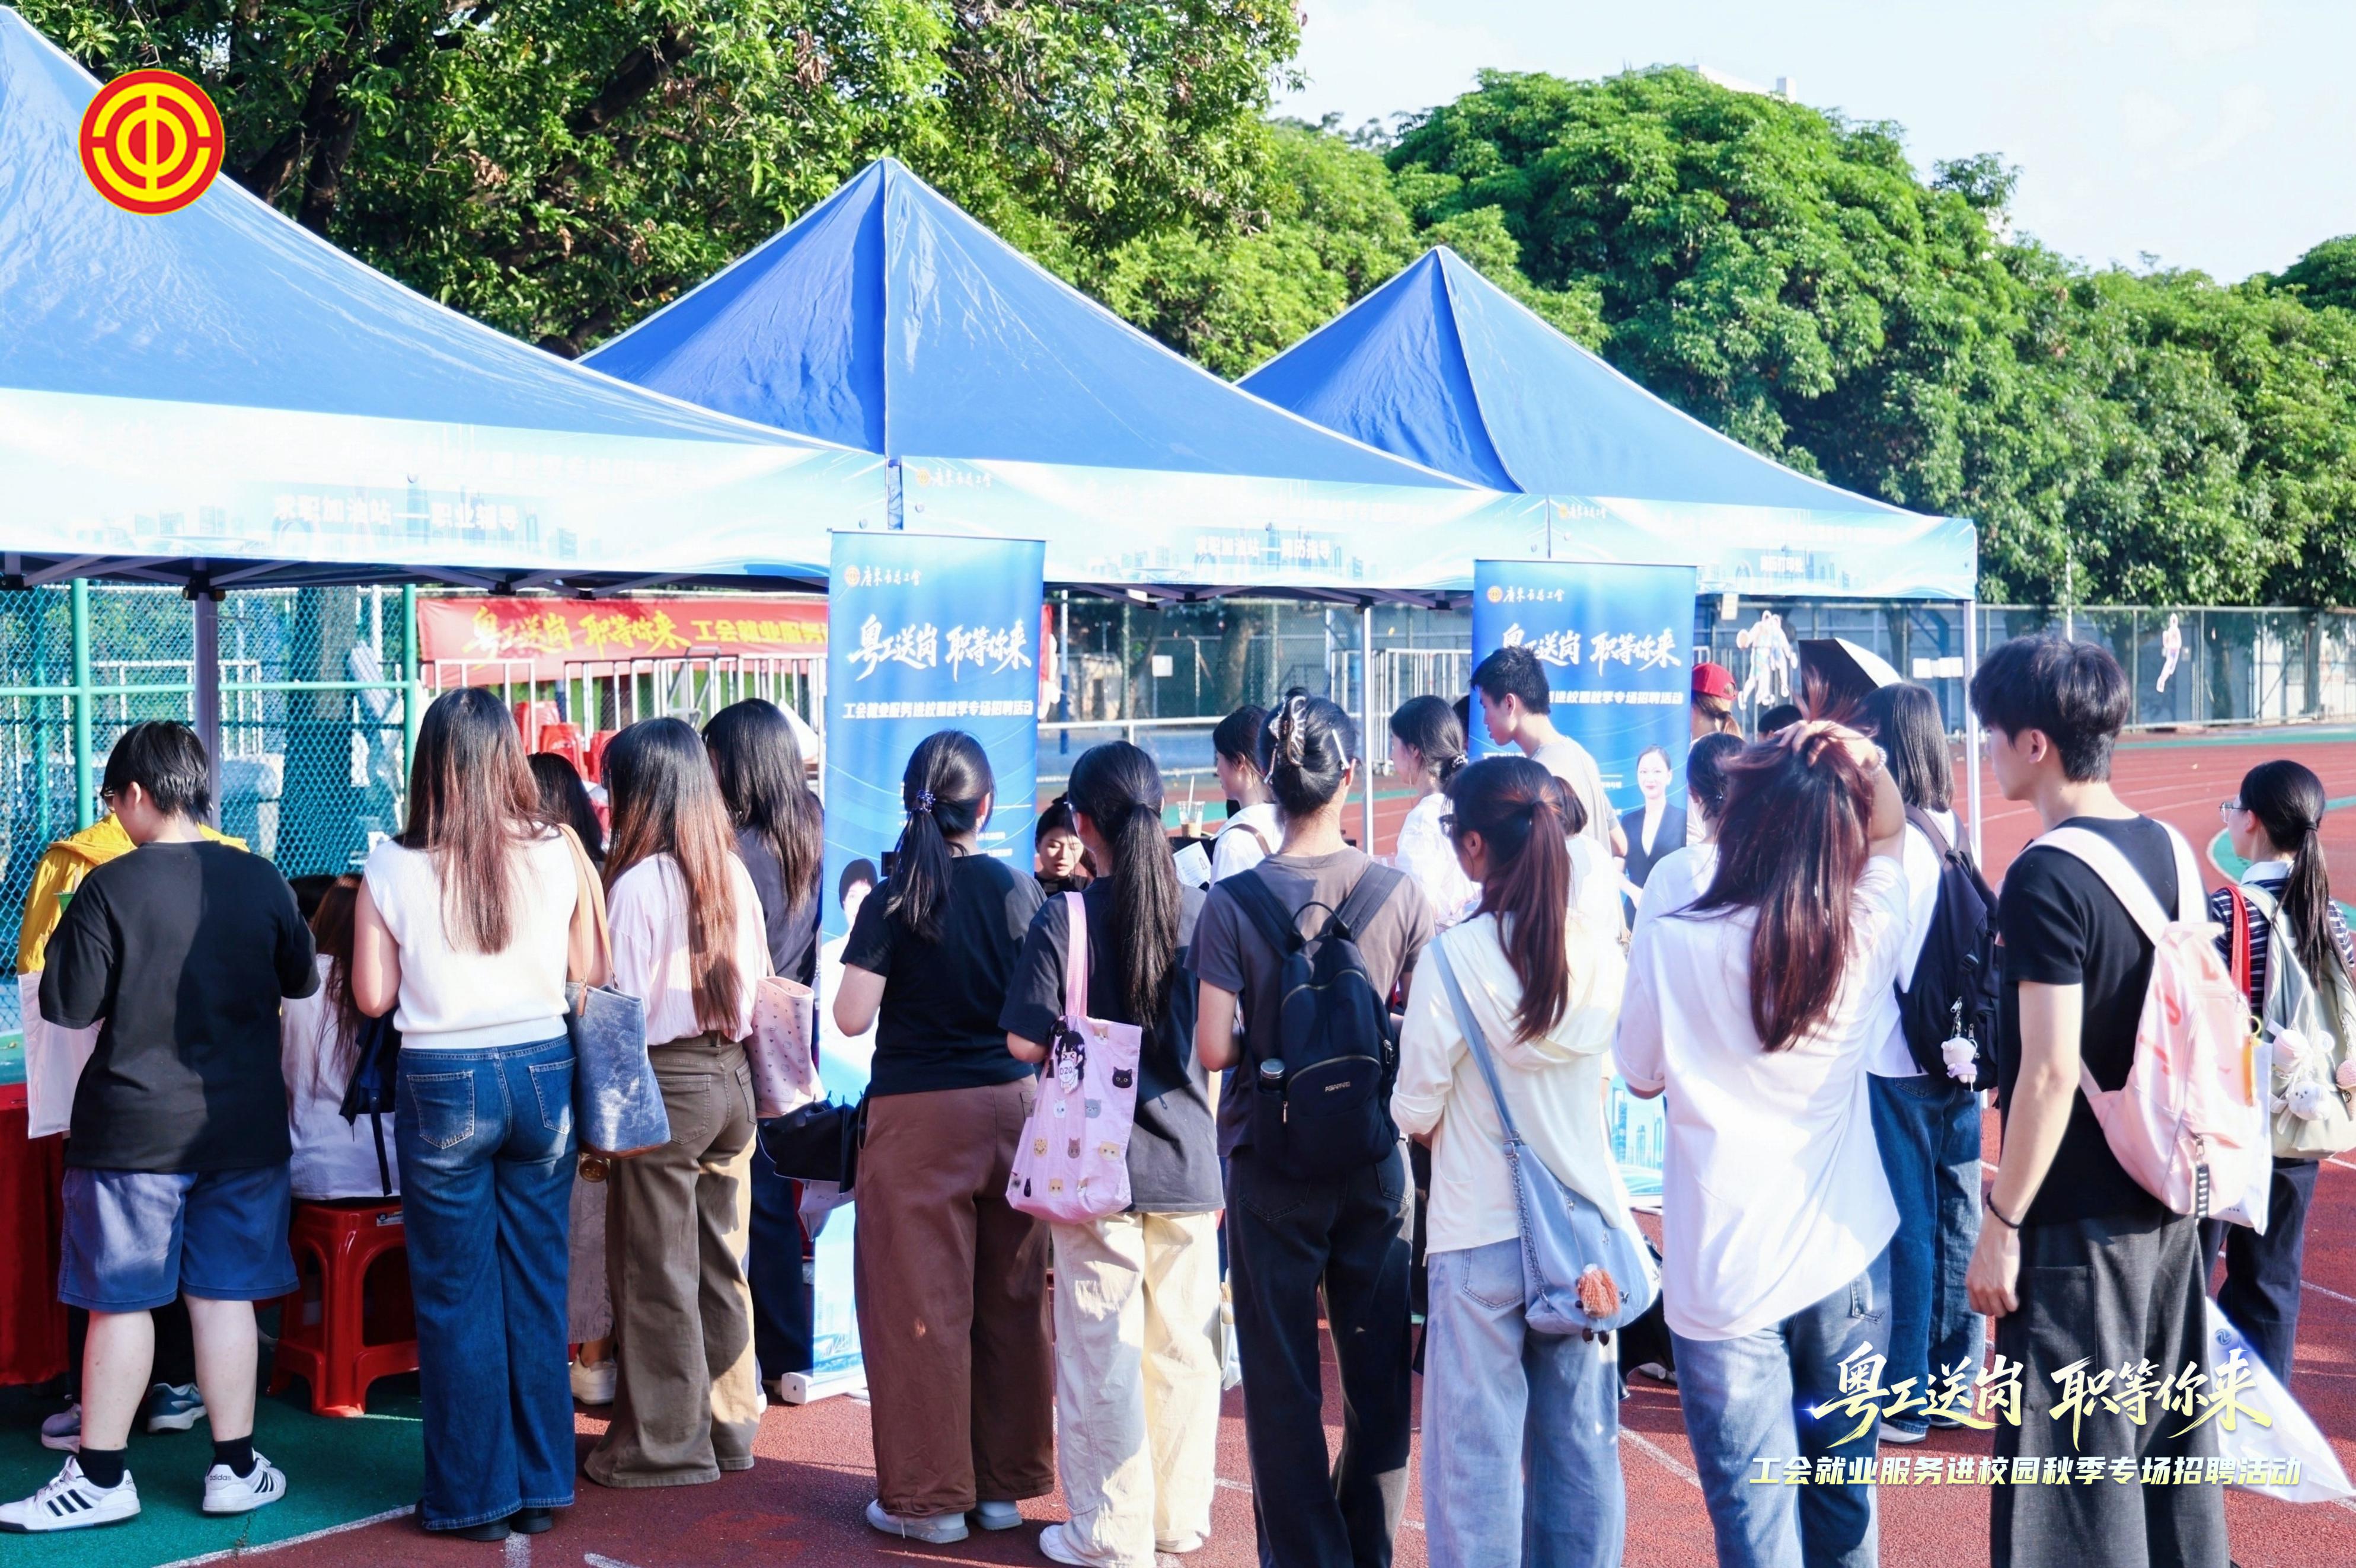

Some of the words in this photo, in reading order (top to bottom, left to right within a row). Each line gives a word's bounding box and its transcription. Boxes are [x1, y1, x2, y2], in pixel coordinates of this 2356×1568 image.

[462, 605, 574, 668] 粤工送岗
[579, 609, 692, 659] 职等你来
[847, 614, 938, 681] 粤工送岗
[945, 618, 1032, 682] 职等你来
[1589, 627, 1682, 677] 职等你来
